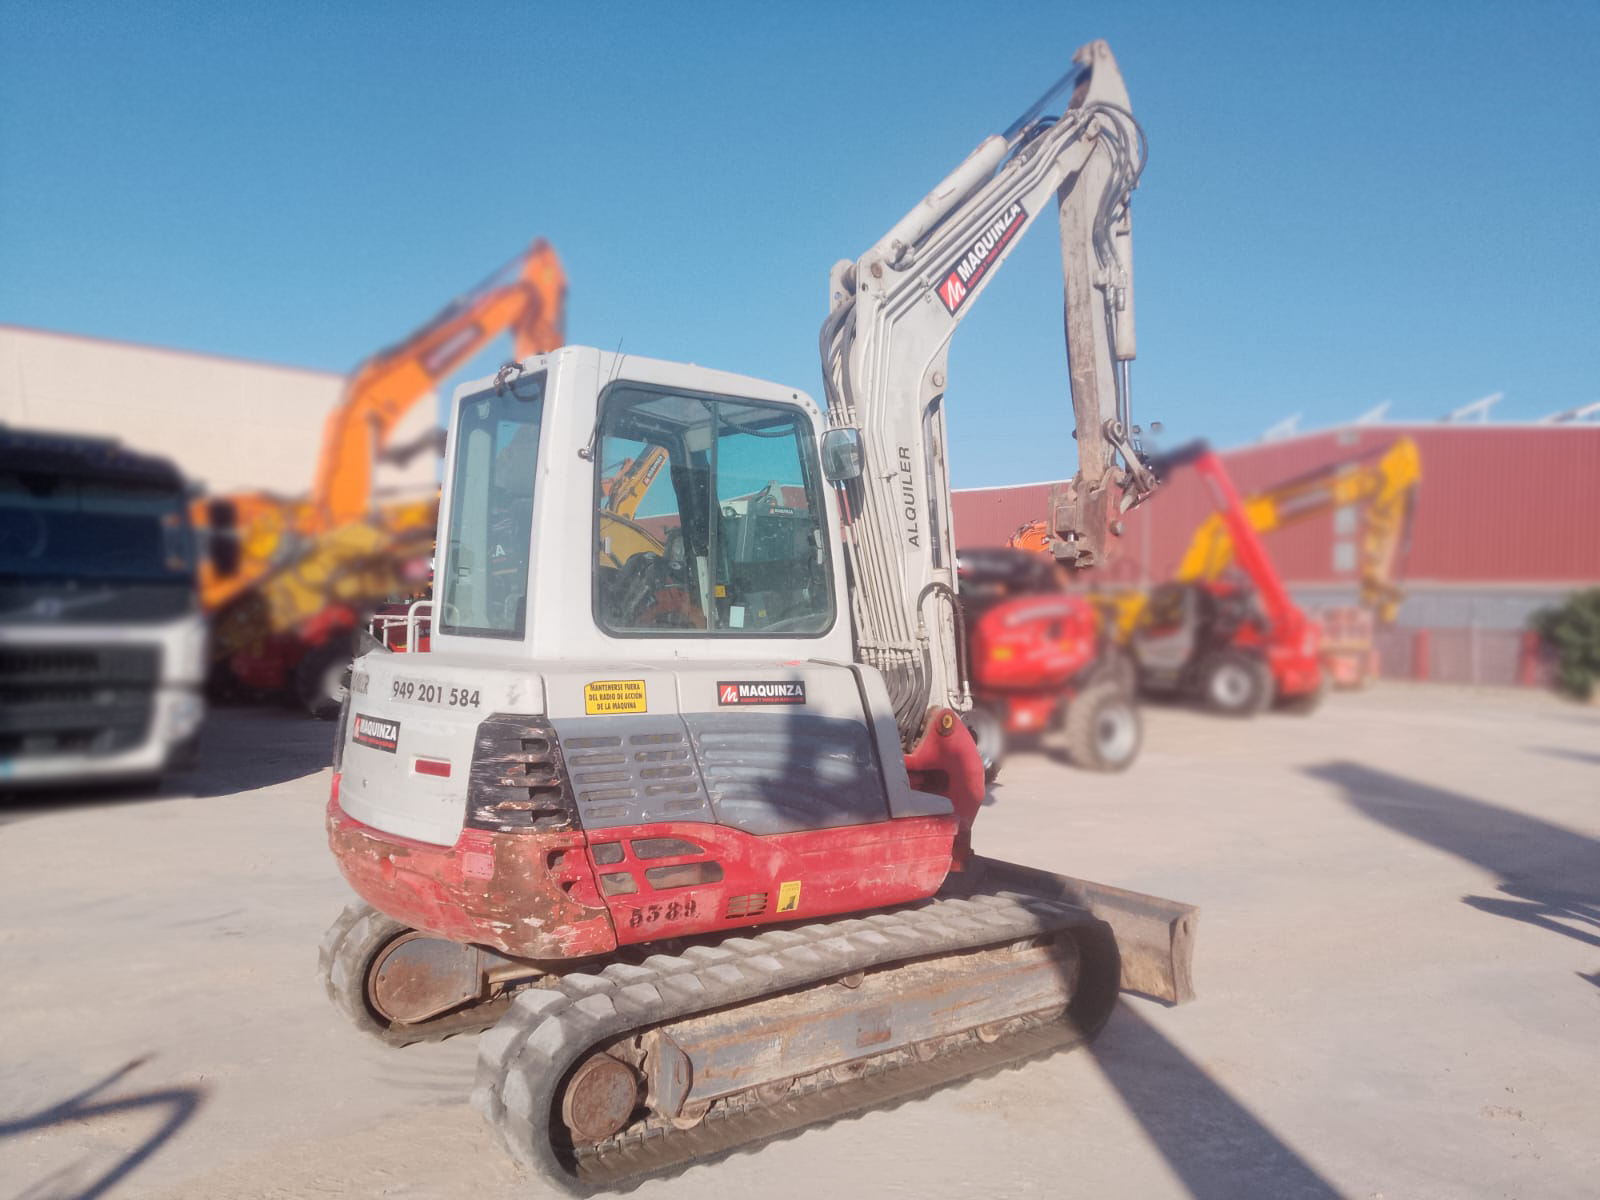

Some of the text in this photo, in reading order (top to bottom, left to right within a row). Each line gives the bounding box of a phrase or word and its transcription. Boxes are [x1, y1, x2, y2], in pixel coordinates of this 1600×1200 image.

[957, 203, 1021, 282] MAQUINZA
[899, 446, 919, 548] ALQUILER
[393, 680, 415, 700] 949
[417, 683, 443, 703] 201
[448, 687, 480, 708] 584
[739, 684, 803, 697] MAQUINZA
